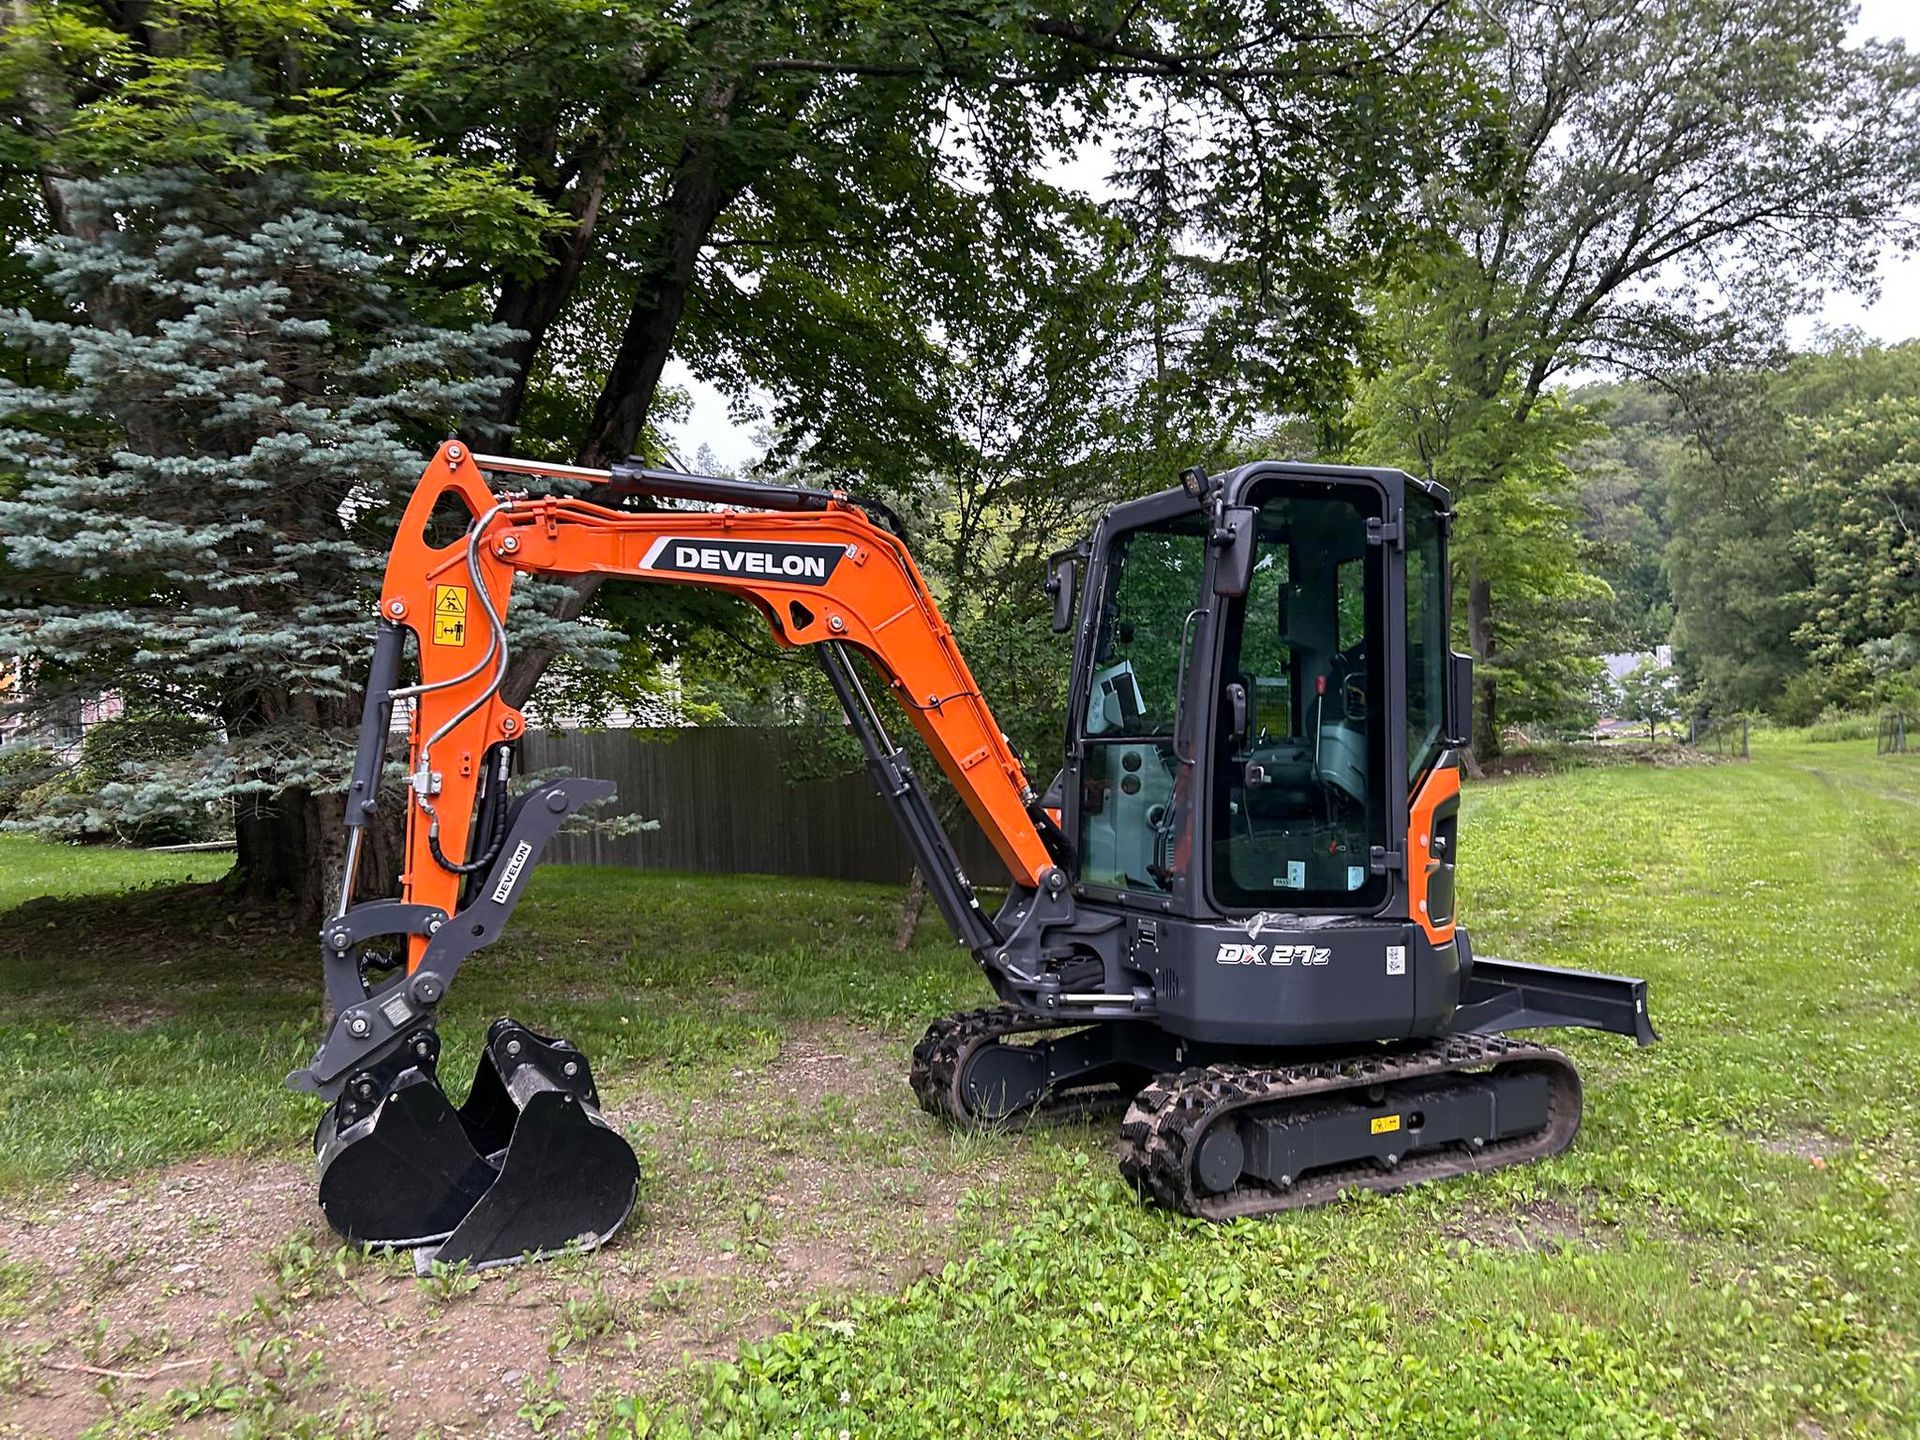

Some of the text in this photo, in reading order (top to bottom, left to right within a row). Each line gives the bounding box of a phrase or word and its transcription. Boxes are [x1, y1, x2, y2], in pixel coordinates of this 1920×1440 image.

[675, 546, 825, 577] DEVELON
[496, 846, 528, 900] DEVELON
[1216, 943, 1267, 966] DX
